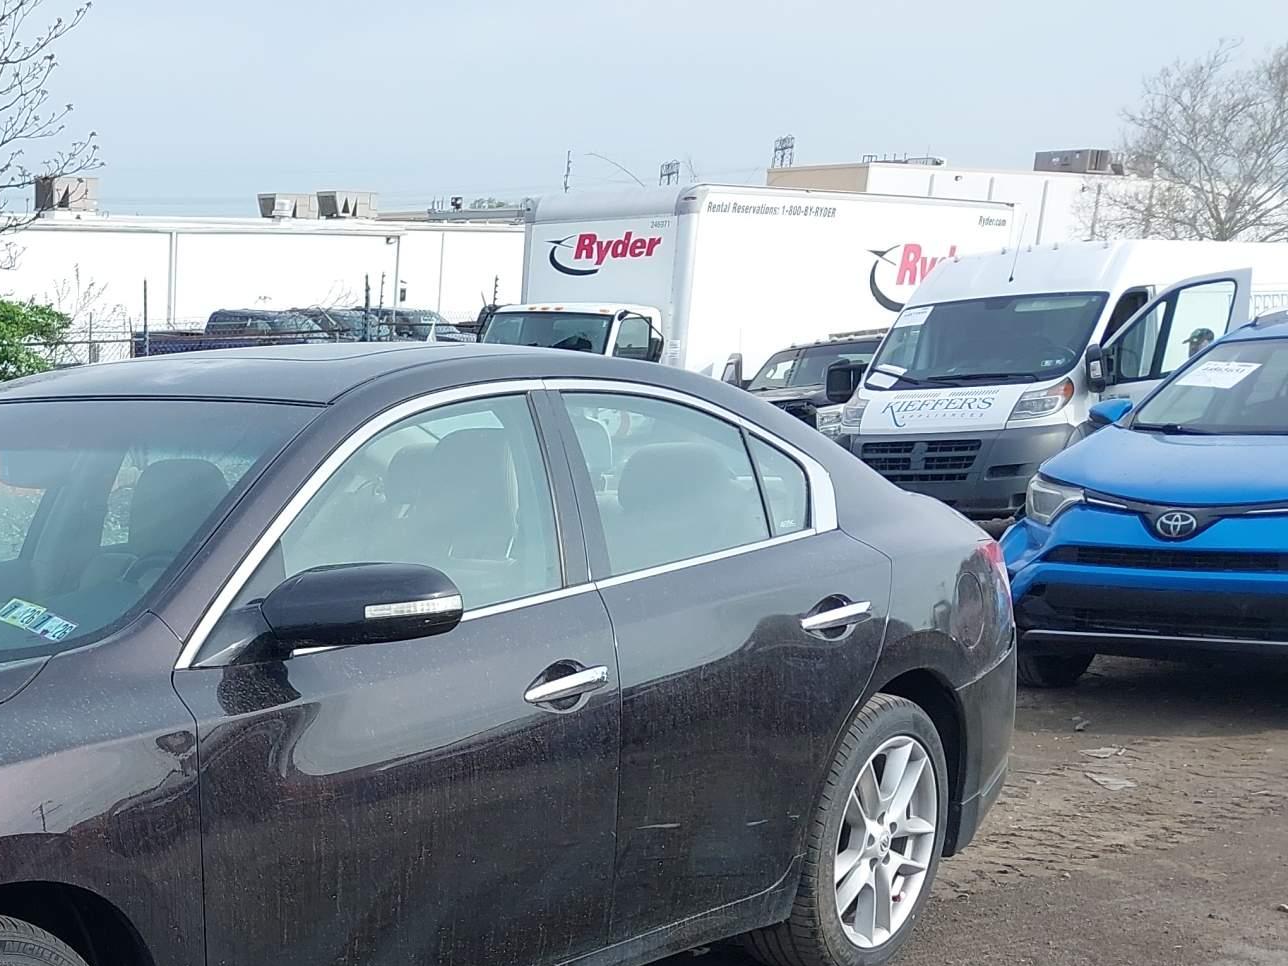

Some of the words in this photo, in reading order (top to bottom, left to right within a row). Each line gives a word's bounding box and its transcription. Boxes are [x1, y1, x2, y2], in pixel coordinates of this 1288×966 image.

[707, 201, 730, 213] Rental
[732, 202, 779, 215] Reservations:
[781, 205, 837, 217] 1-800-BY-RYDER
[978, 215, 1007, 227] Ryder.com
[574, 231, 662, 265] Ryder
[882, 397, 995, 427] KIEFFER'S
